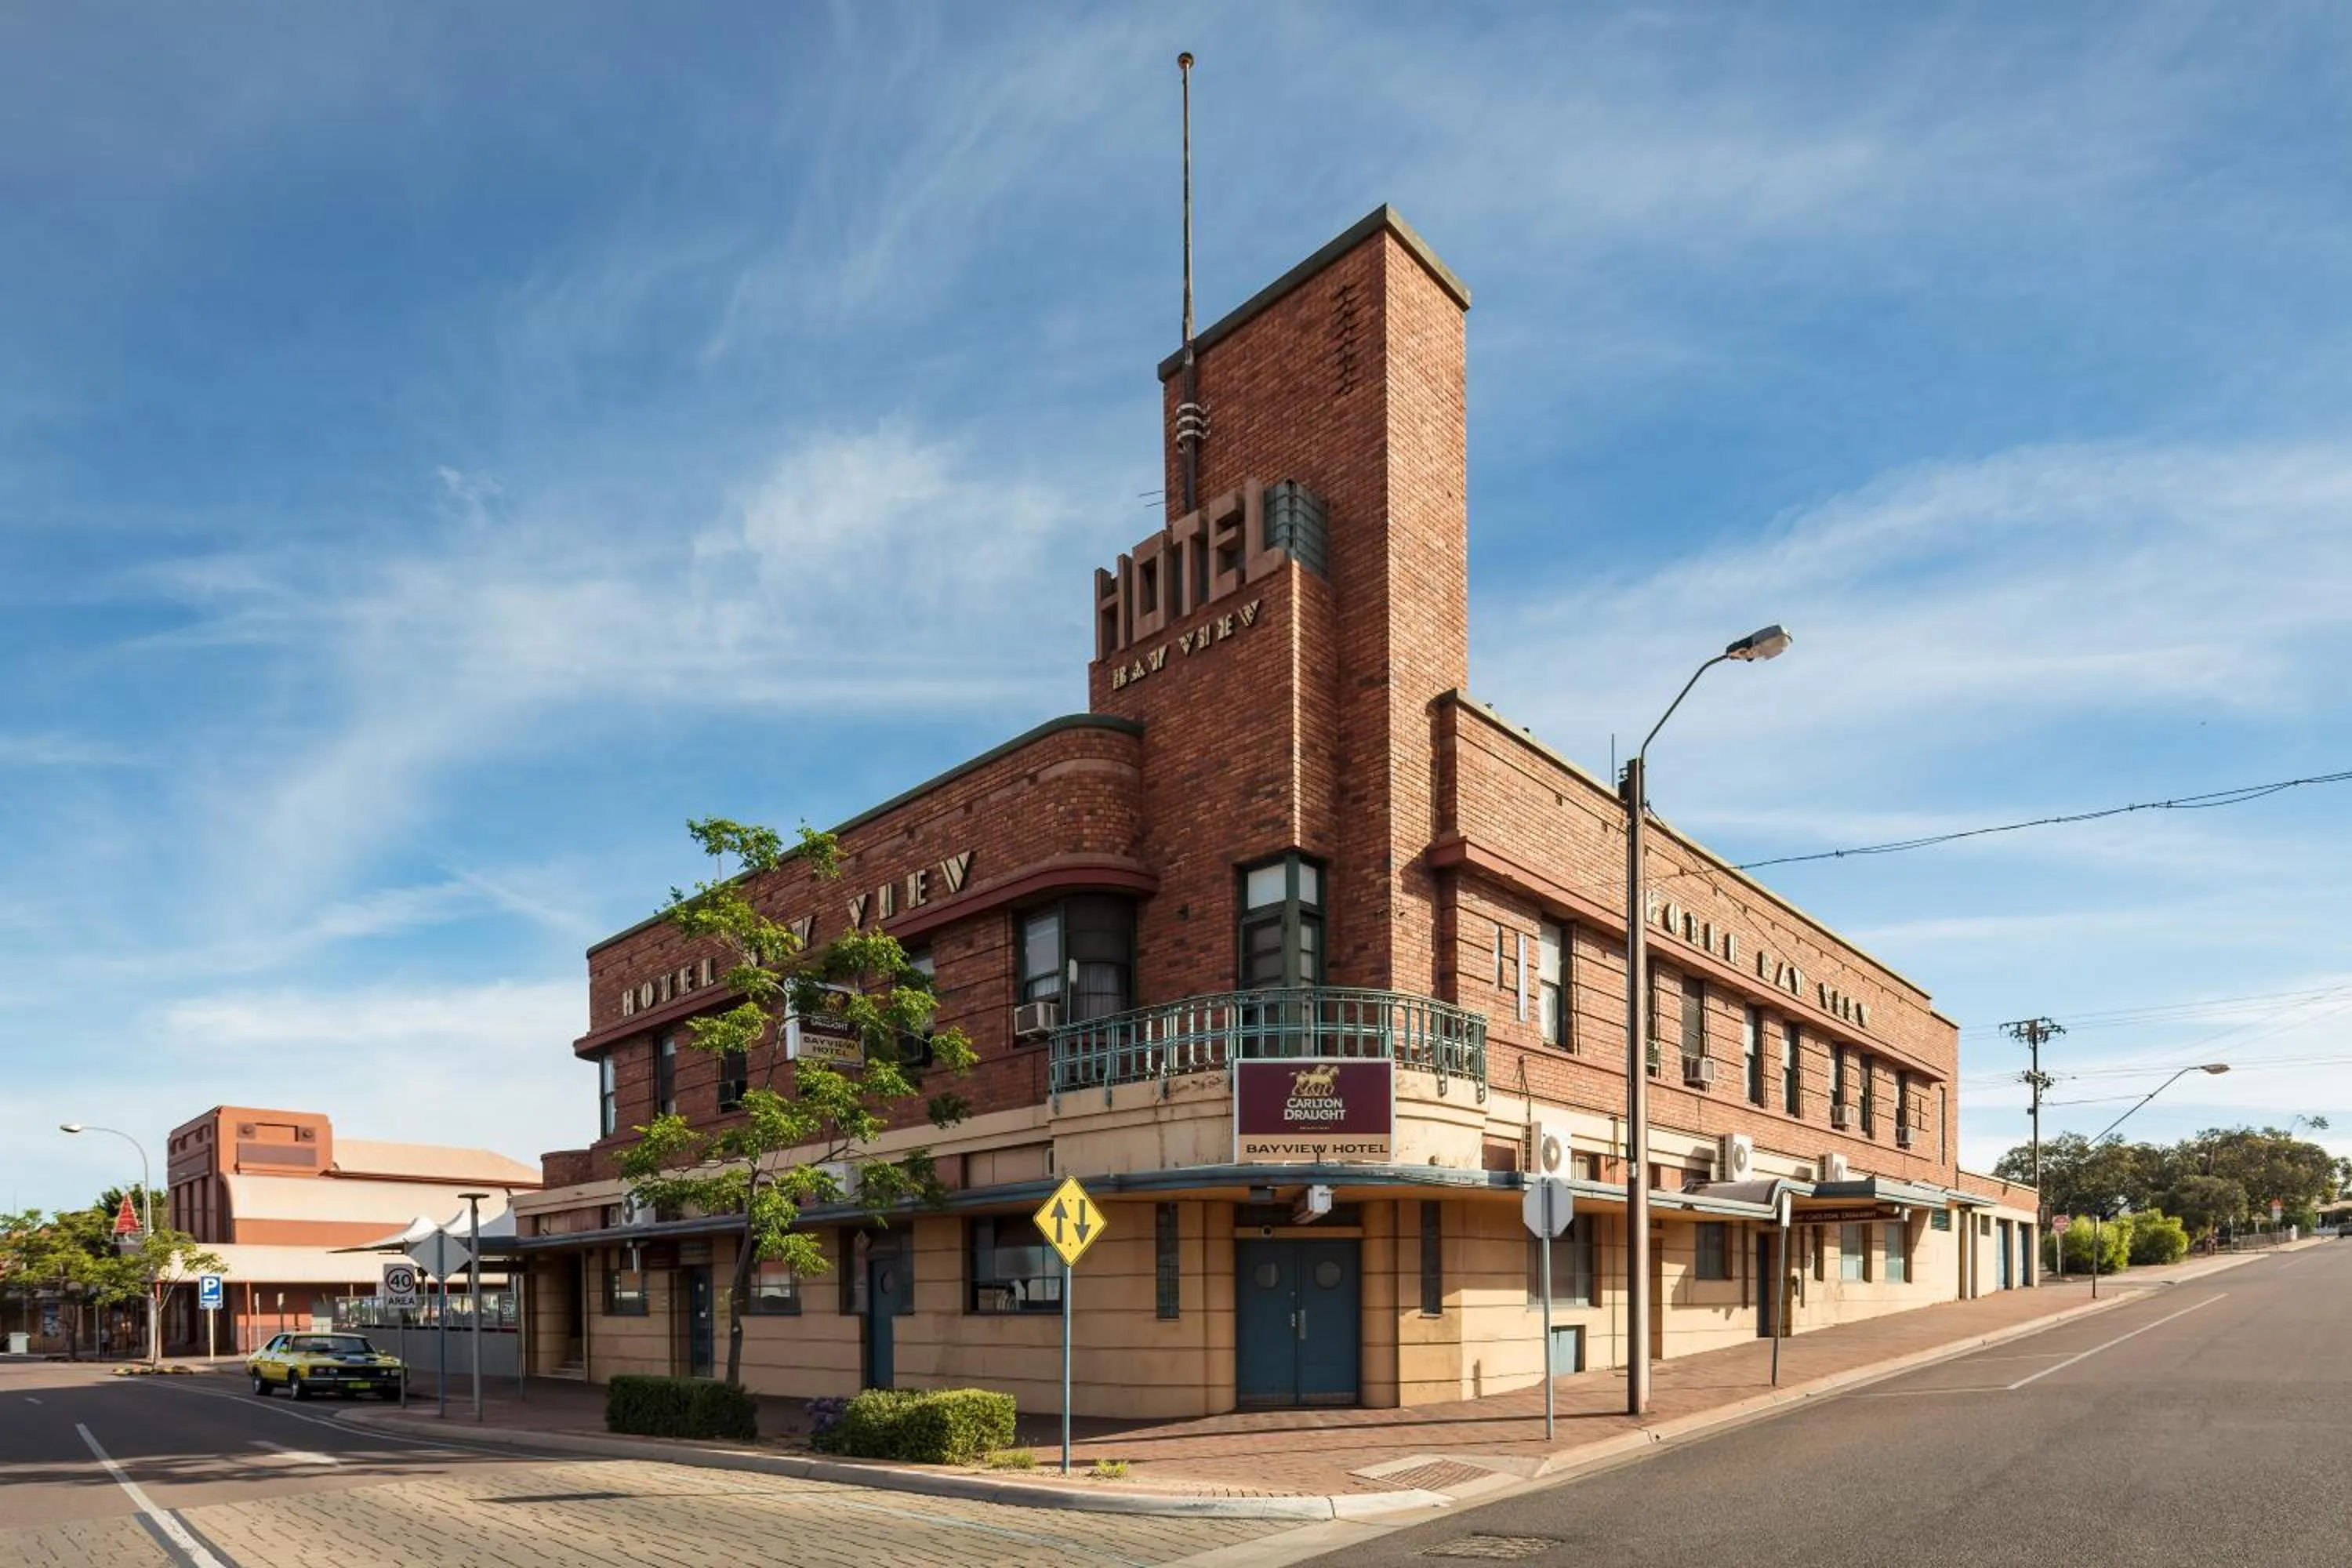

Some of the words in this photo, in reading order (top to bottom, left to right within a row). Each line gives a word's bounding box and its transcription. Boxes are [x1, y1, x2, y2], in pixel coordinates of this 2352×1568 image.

[1094, 477, 1286, 663] HOTEL
[1112, 644, 1170, 691] BAY
[1179, 598, 1262, 657] VIEW
[622, 957, 715, 1017] HOTEL
[848, 851, 971, 928] VIEW
[813, 1046, 849, 1057] HOTEL
[1287, 1098, 1343, 1109] CARLTON
[1283, 1109, 1346, 1120] DRAUGHT
[1246, 1144, 1327, 1153] BAYVIEW
[1333, 1144, 1389, 1153] HOTEL
[204, 1278, 219, 1293] P
[390, 1274, 412, 1288] 40
